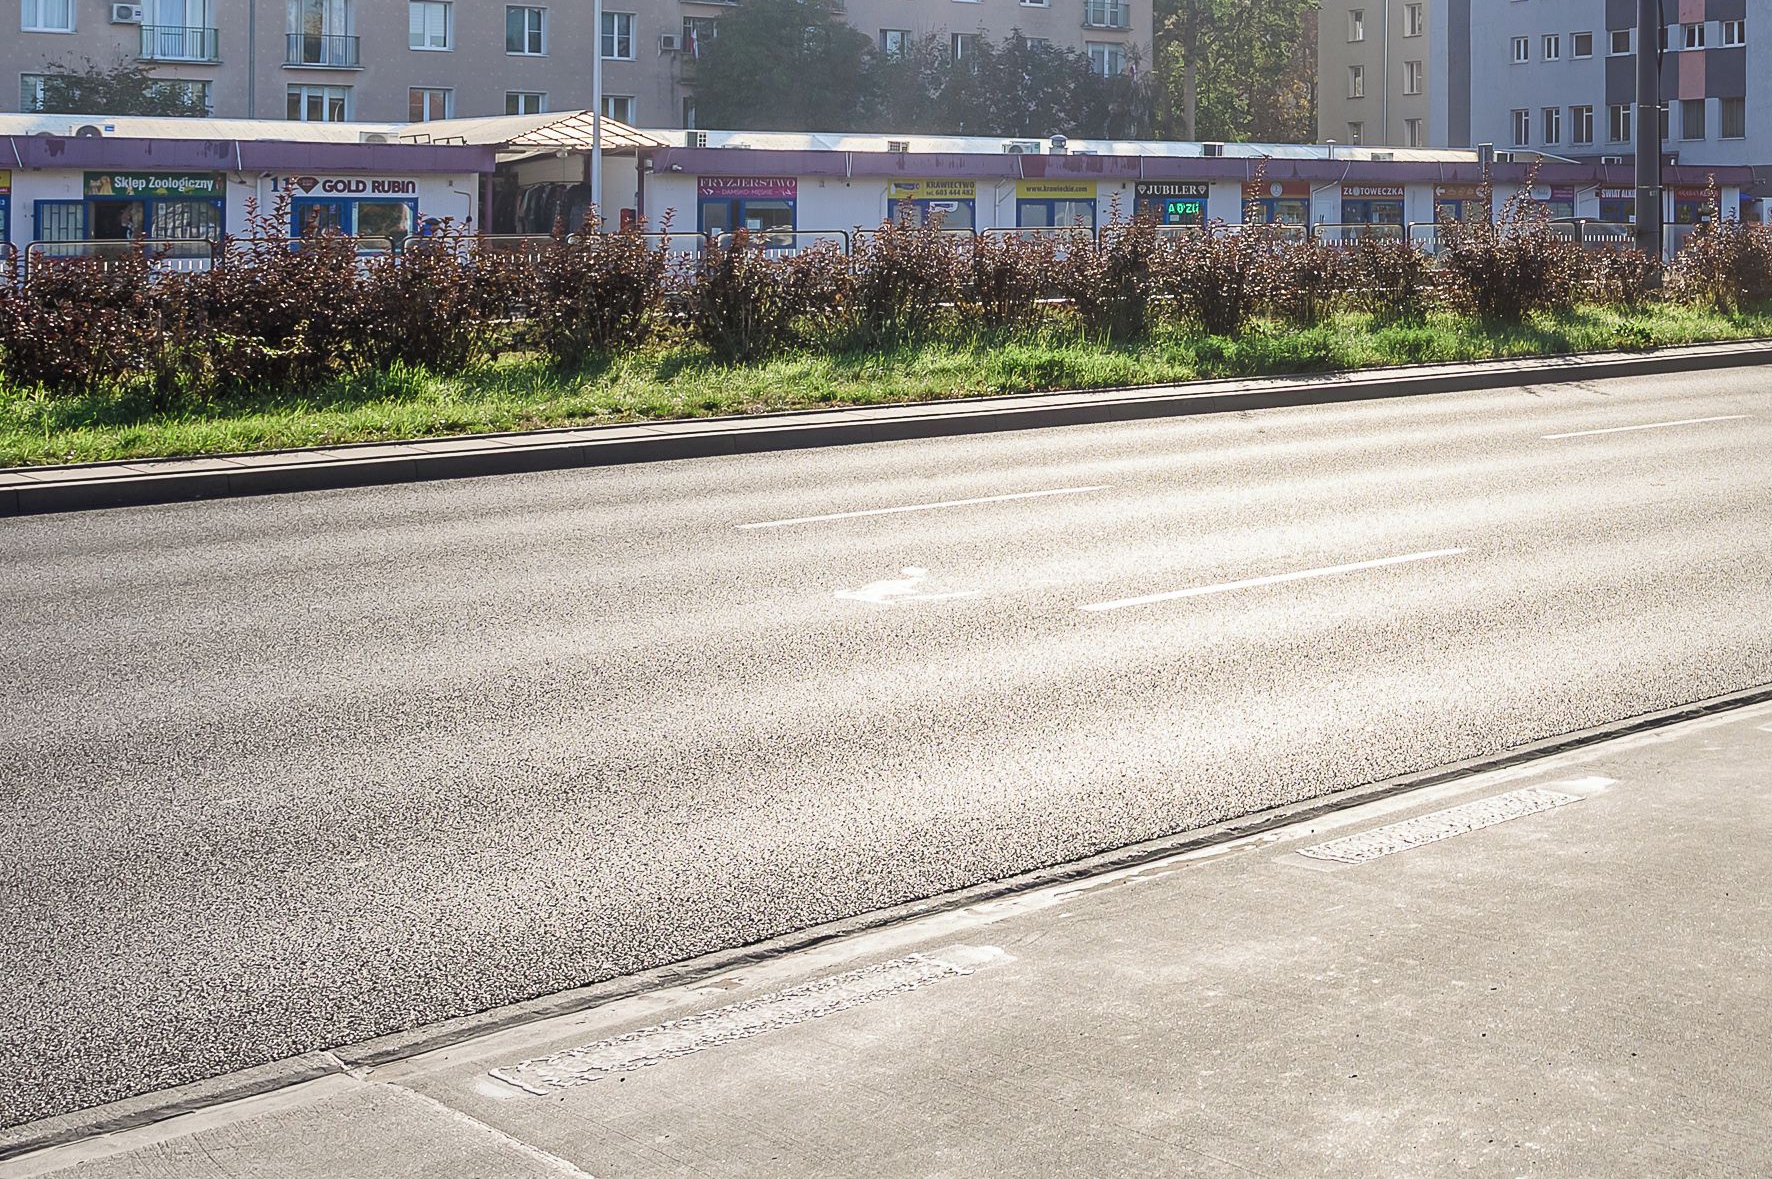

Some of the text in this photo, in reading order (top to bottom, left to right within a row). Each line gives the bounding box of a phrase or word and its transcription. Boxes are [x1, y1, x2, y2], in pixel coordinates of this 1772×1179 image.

[114, 176, 213, 191] Sklep Zoologiczny
[322, 179, 367, 193] GOLD
[700, 177, 795, 187] FRYZJERSTWO
[926, 181, 975, 189] KRAWIECTWO
[1147, 185, 1197, 195] JUBILER
